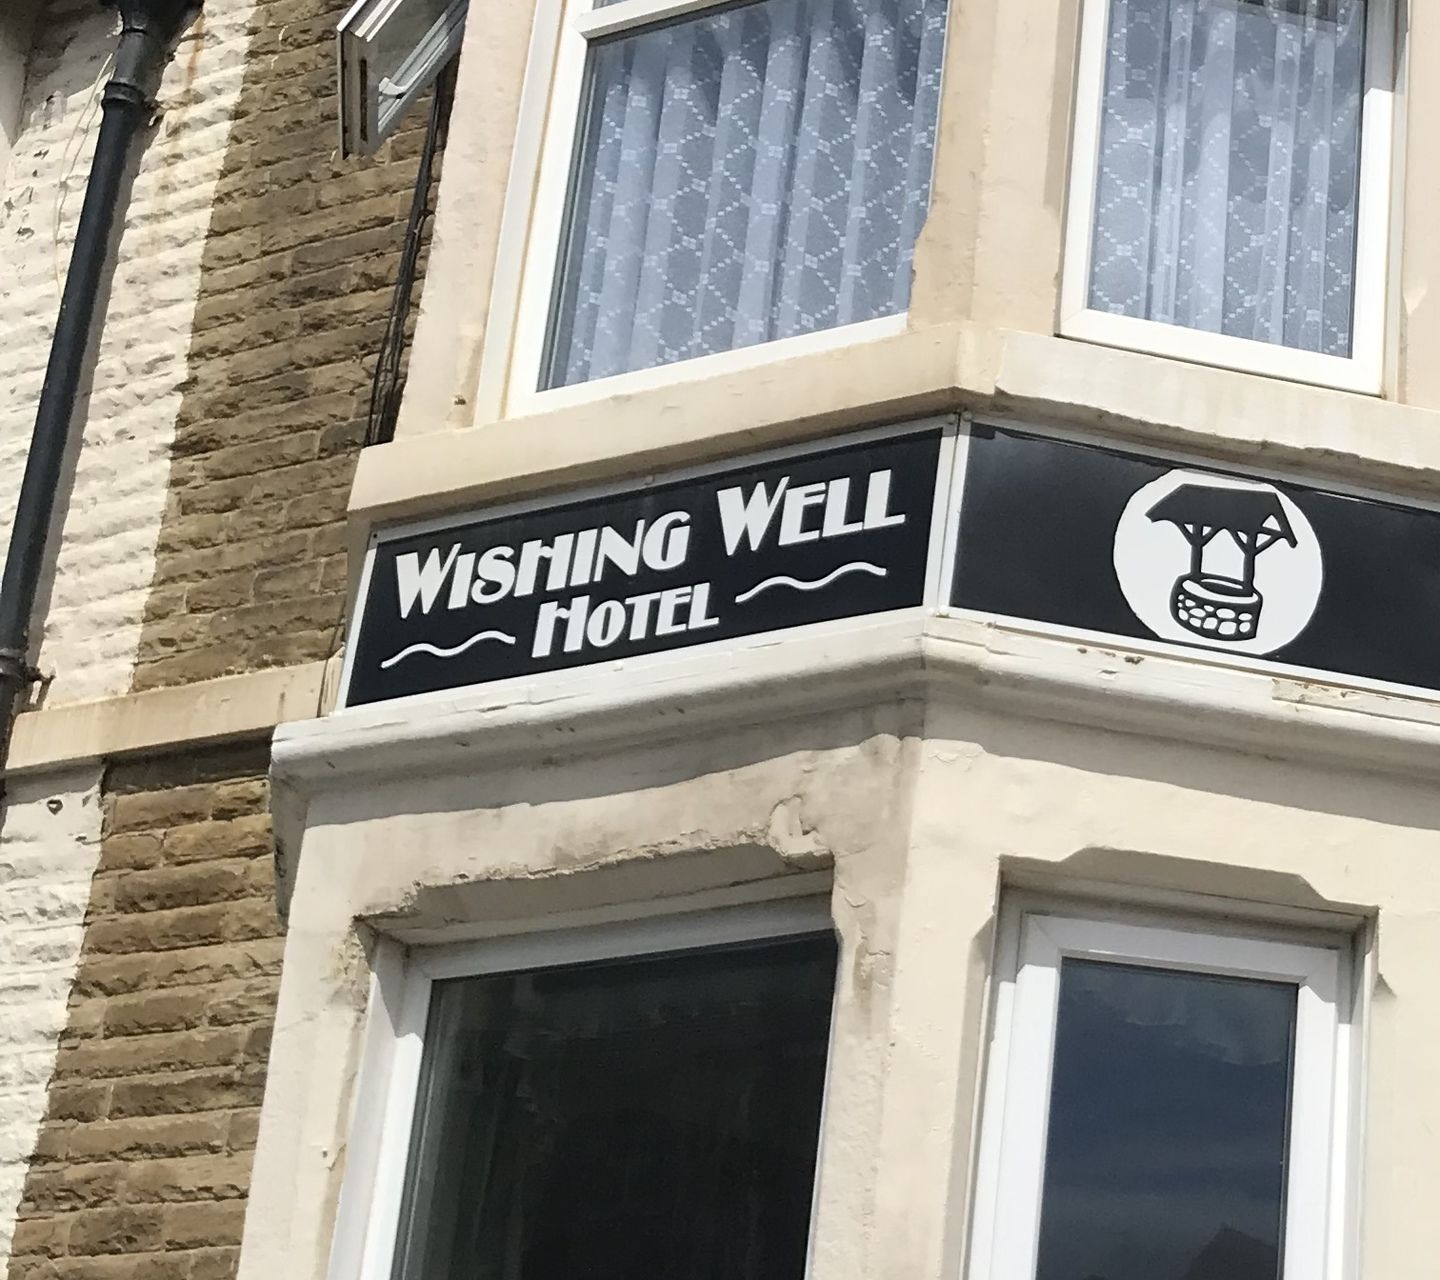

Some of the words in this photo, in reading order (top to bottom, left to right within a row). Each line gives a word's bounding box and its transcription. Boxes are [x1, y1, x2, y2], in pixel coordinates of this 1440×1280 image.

[395, 510, 691, 620] WISHING
[716, 468, 906, 556] WELL
[531, 582, 720, 659] HOTEL
